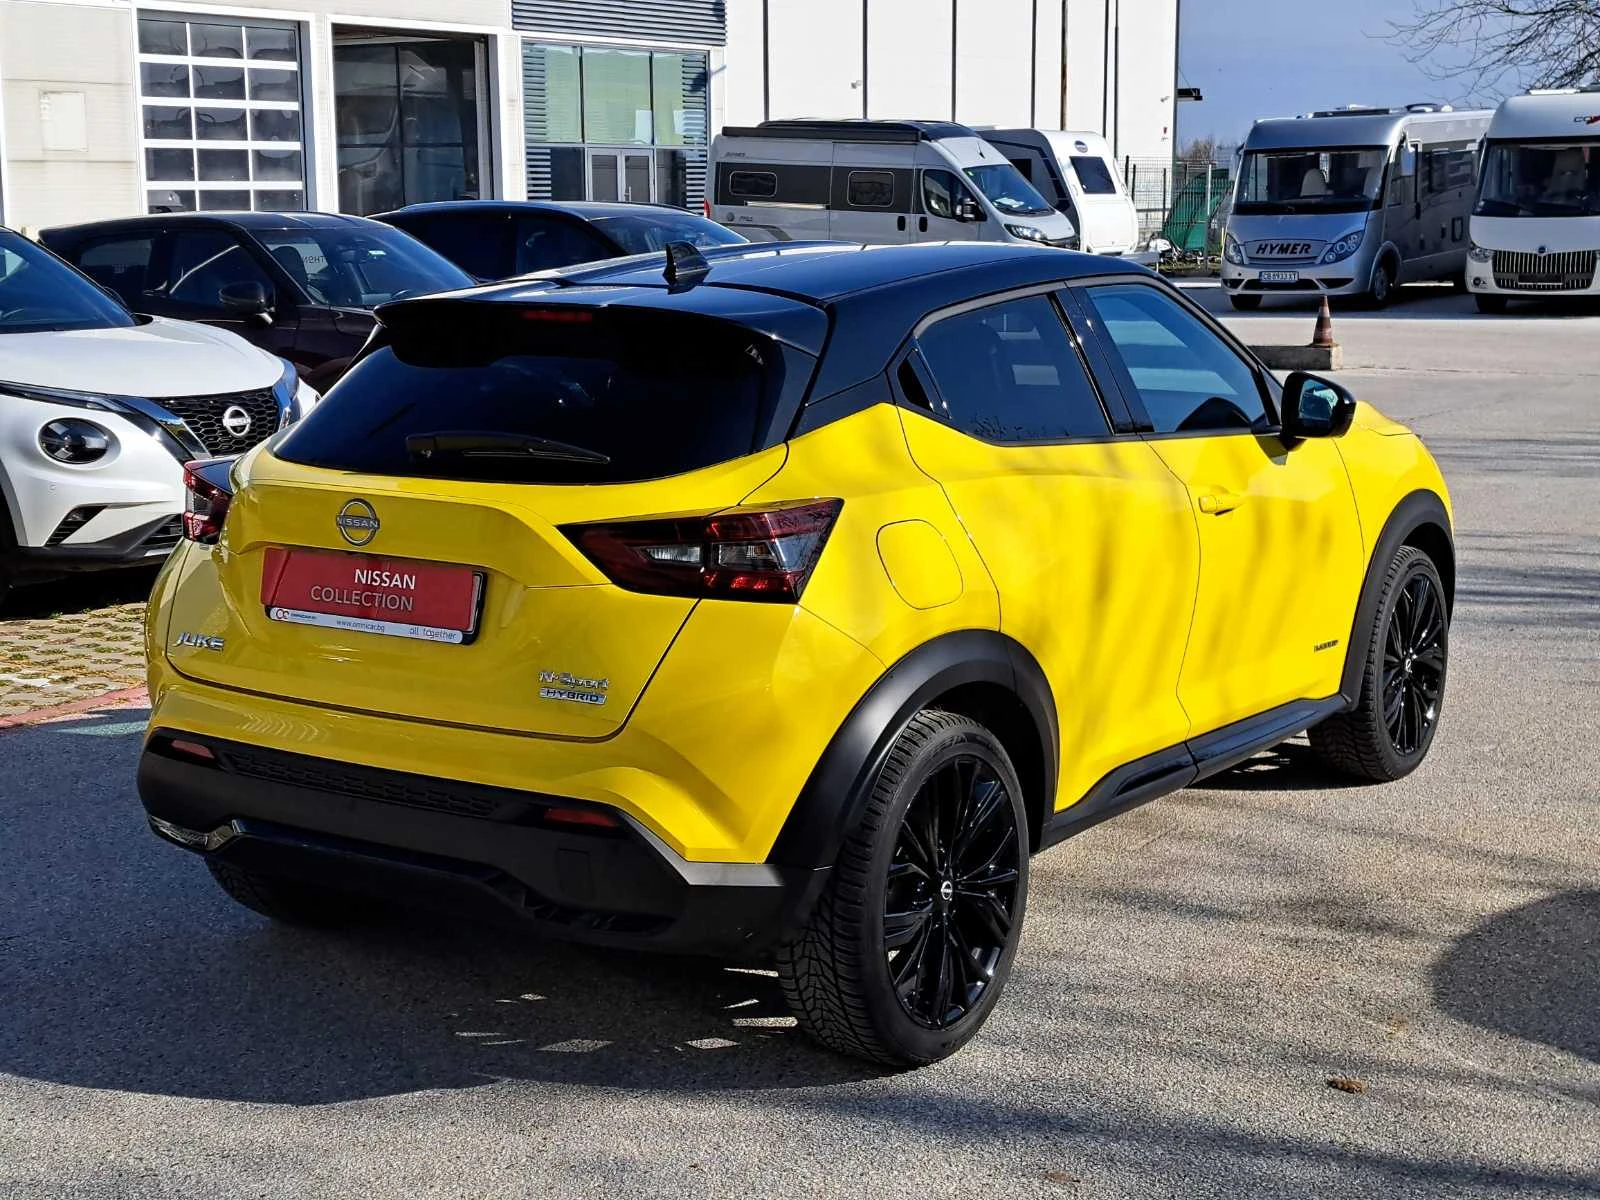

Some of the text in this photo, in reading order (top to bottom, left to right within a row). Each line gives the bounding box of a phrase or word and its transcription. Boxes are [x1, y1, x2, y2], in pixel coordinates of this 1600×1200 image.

[1255, 243, 1312, 255] HYMER
[336, 516, 379, 528] NISSAN
[354, 568, 416, 590] NISSAN
[311, 585, 413, 611] COLLECTION
[172, 632, 225, 651] JUKE
[546, 689, 599, 702] HYBRID
